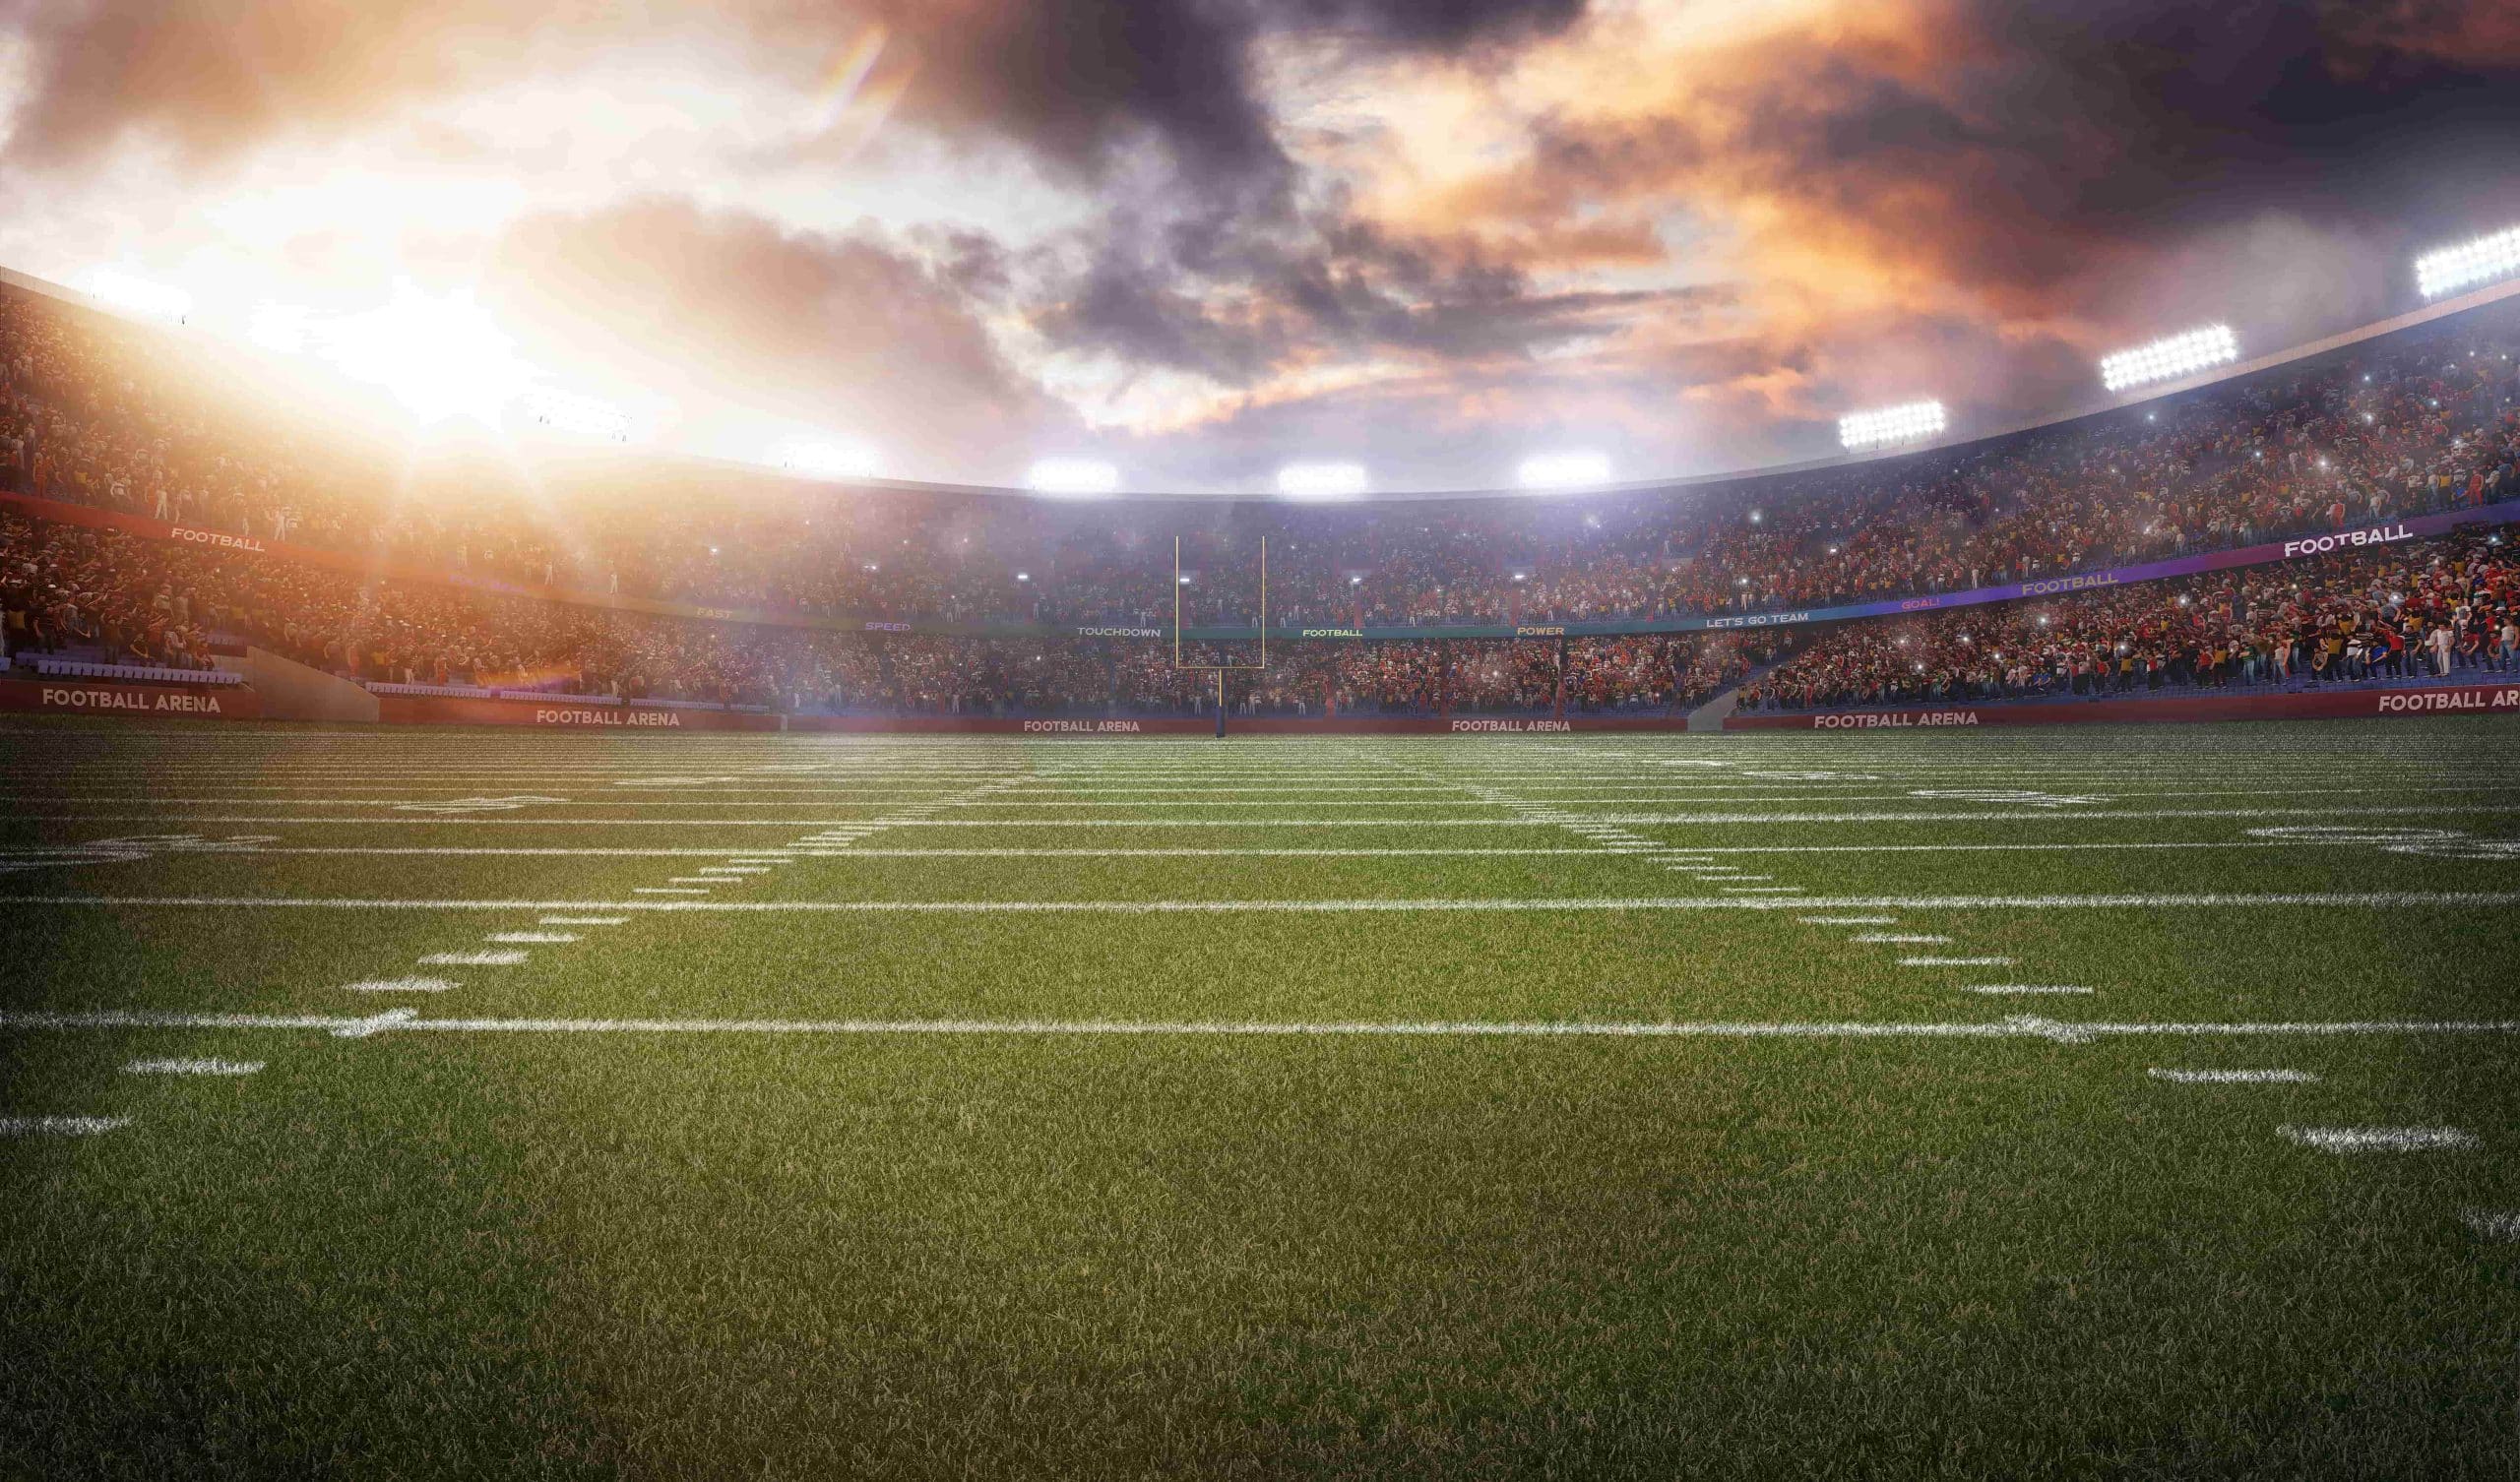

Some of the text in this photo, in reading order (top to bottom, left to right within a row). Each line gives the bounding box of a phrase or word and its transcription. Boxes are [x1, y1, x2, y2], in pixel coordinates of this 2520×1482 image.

[171, 527, 266, 552] FOOTBALL
[2284, 525, 2414, 558] FOOTBALL
[2022, 574, 2119, 595] FOOTBALL
[865, 622, 912, 632] SPEED
[1706, 612, 1809, 628] LET'S GO TEAM
[1077, 627, 1162, 638] TOUCHDOWN
[1302, 629, 1363, 638] FOOTBALL
[1517, 627, 1565, 636] POWER
[42, 688, 221, 713] FOOTBALL ARENA
[2378, 691, 2487, 712] FOOTBALL
[536, 710, 680, 726] FOOTBALL ARENA
[1024, 720, 1141, 732] FOOTBALL ARENA
[1452, 720, 1571, 732] FOOTBALL ARENA
[1814, 711, 1979, 729] FOOTBALL ARENA
